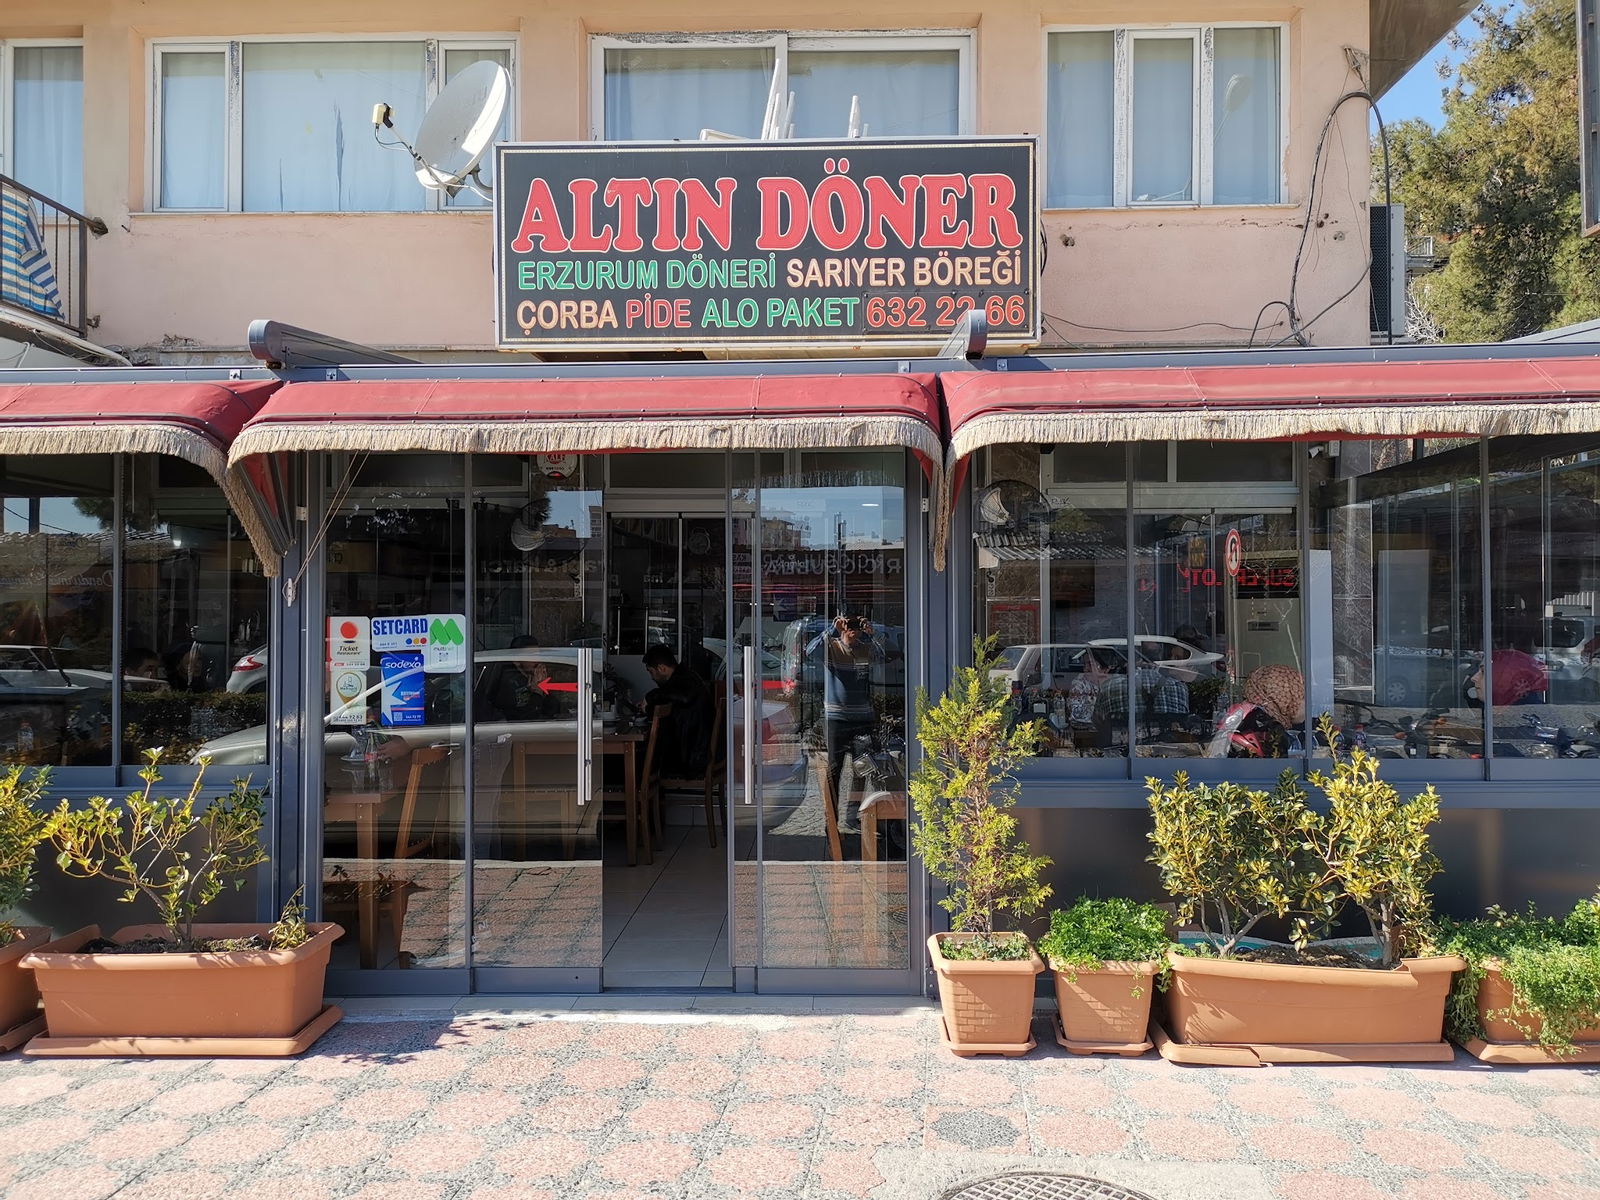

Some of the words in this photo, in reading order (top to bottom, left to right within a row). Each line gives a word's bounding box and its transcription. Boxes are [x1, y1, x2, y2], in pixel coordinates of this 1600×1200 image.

[511, 176, 737, 253] ALTIN
[755, 157, 1023, 253] DÖNER
[518, 259, 658, 291] ERZURUM
[666, 252, 777, 289] DÖNERİ
[786, 257, 906, 288] SARIYER
[913, 249, 1022, 287] BÖREĞİ
[516, 299, 618, 335] ÇORBA
[625, 292, 691, 329] PİDE
[701, 298, 759, 328] ALO
[766, 297, 860, 328] PAKET
[866, 296, 927, 328] 632
[985, 295, 1026, 326] 66
[373, 618, 428, 636] SETCARD
[385, 657, 421, 669] sodexo
